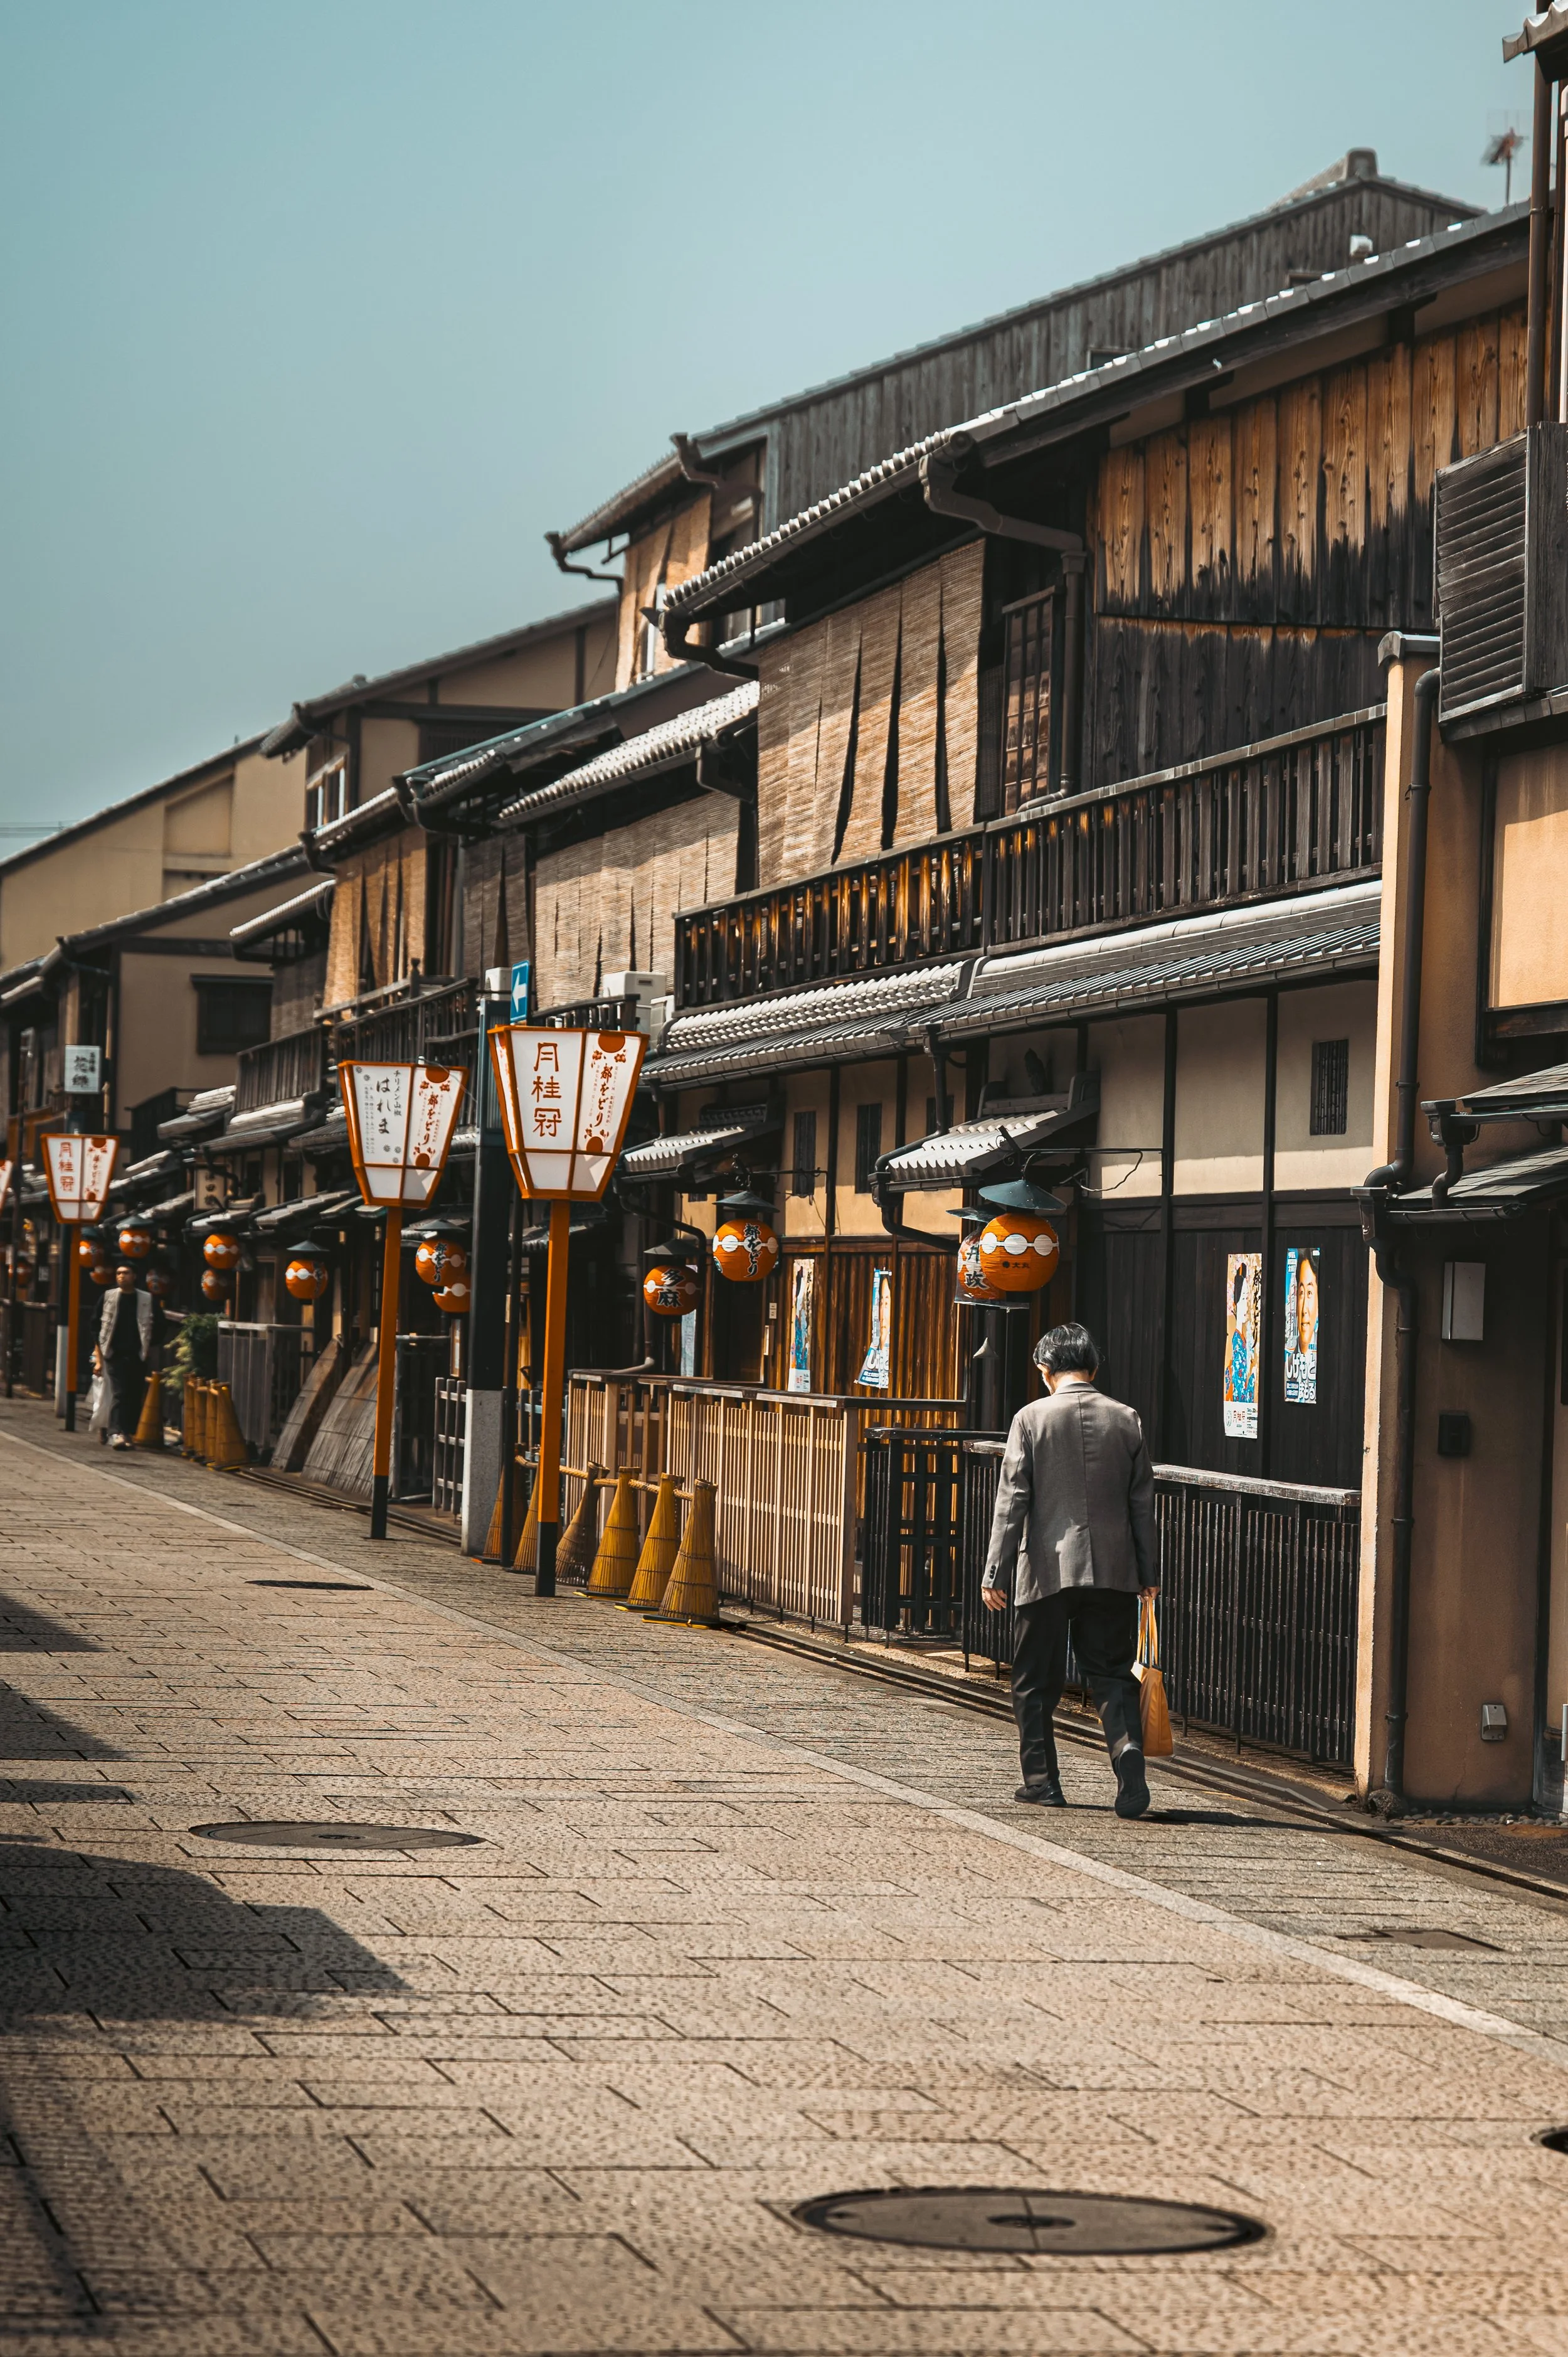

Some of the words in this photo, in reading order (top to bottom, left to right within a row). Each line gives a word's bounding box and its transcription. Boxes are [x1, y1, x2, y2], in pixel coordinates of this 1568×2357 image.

[376, 1077, 391, 1134] はれま
[393, 1070, 402, 1117] チリメン山椒
[531, 1042, 563, 1137] 月桂冠
[594, 1062, 613, 1127] 都をどり
[421, 1091, 439, 1146] 都をどり
[58, 1141, 75, 1192] 月桂冠
[743, 1223, 761, 1279] 都をどり
[656, 1268, 686, 1308] 多麻
[1286, 1351, 1317, 1381] しげもと
